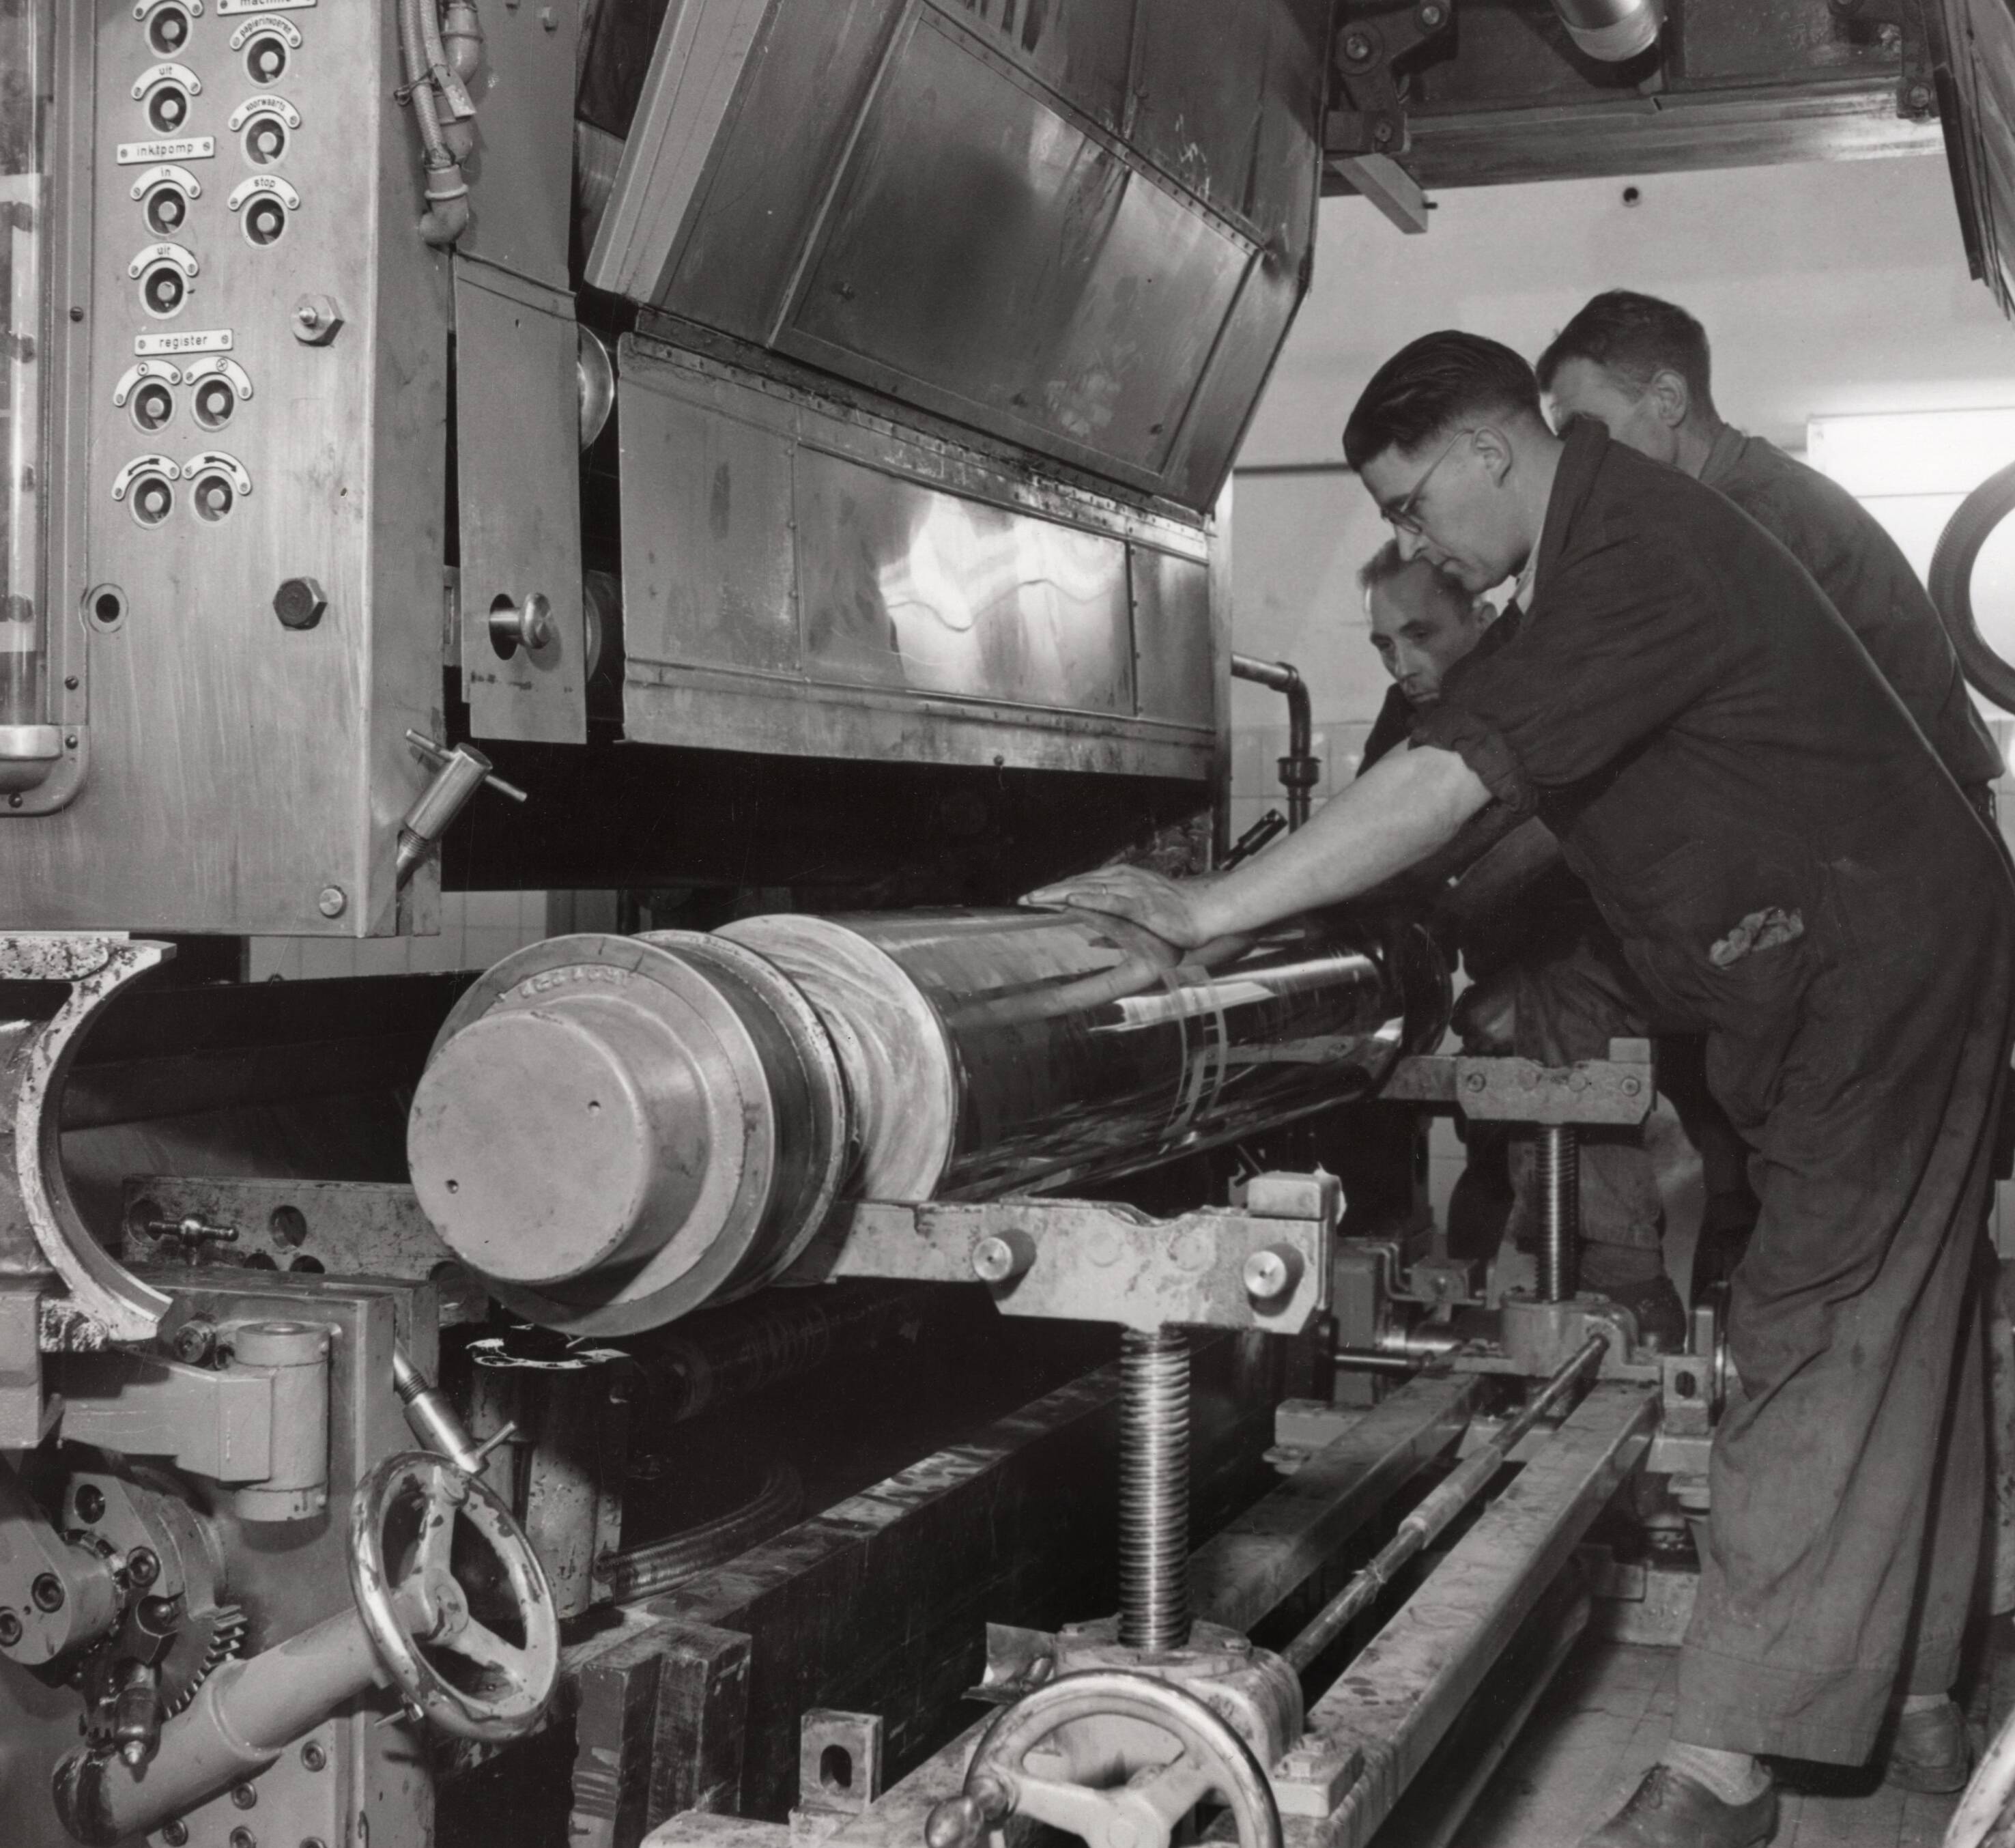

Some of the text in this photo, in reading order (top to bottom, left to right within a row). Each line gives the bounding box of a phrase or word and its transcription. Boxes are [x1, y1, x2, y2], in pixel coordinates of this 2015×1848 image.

[159, 66, 173, 76] uit
[246, 98, 286, 111] voorwaarts
[137, 143, 194, 156] inktpomp
[161, 168, 171, 177] in
[254, 177, 276, 188] stop
[157, 246, 171, 255] uit
[160, 335, 208, 350] register
